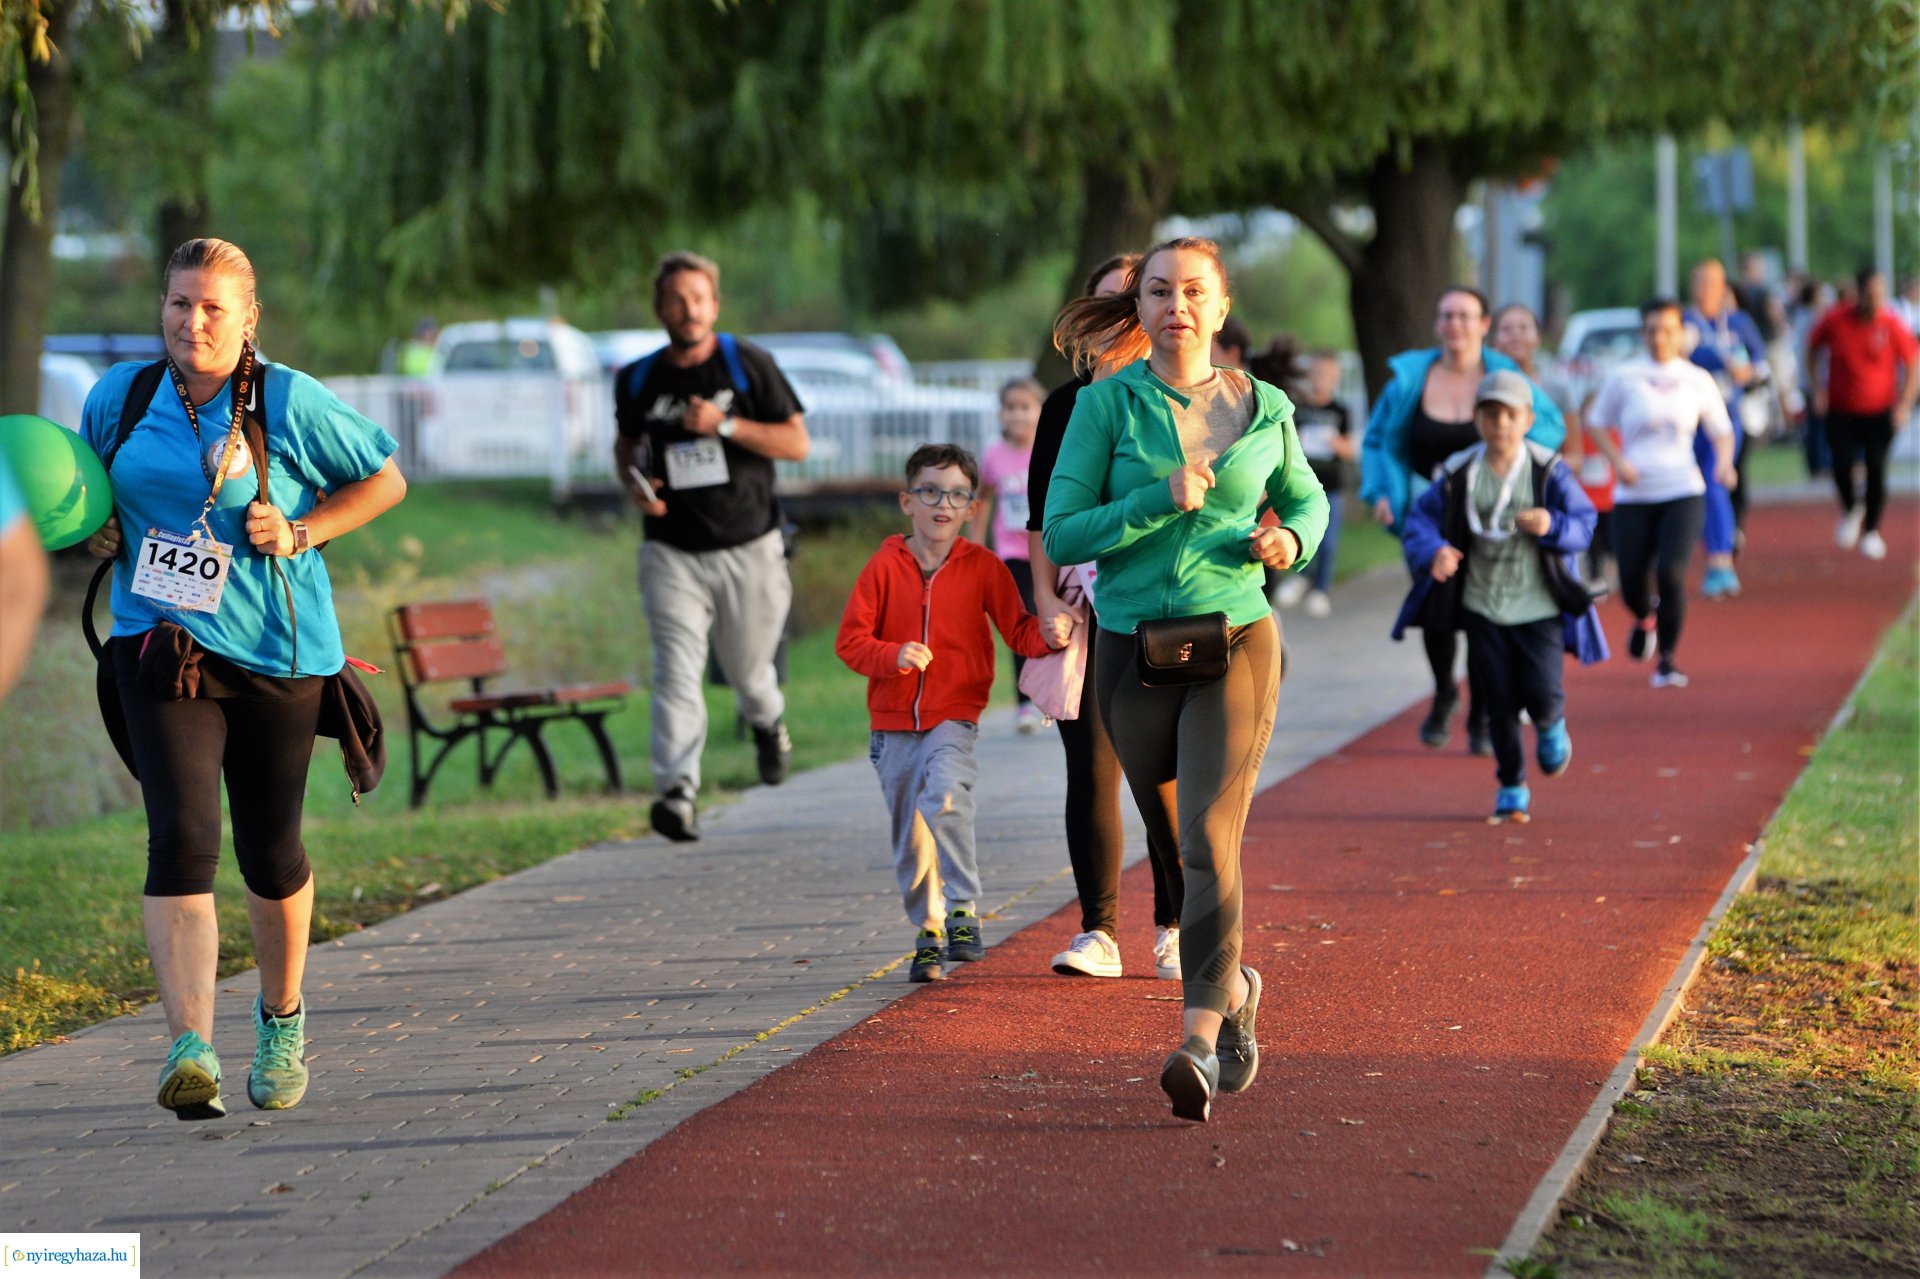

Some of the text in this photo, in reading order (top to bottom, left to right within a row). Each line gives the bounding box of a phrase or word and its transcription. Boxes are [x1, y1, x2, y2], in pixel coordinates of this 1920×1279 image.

[148, 543, 220, 580] 1420
[1253, 718, 1273, 770] PUMA
[1202, 942, 1238, 983] PUMA
